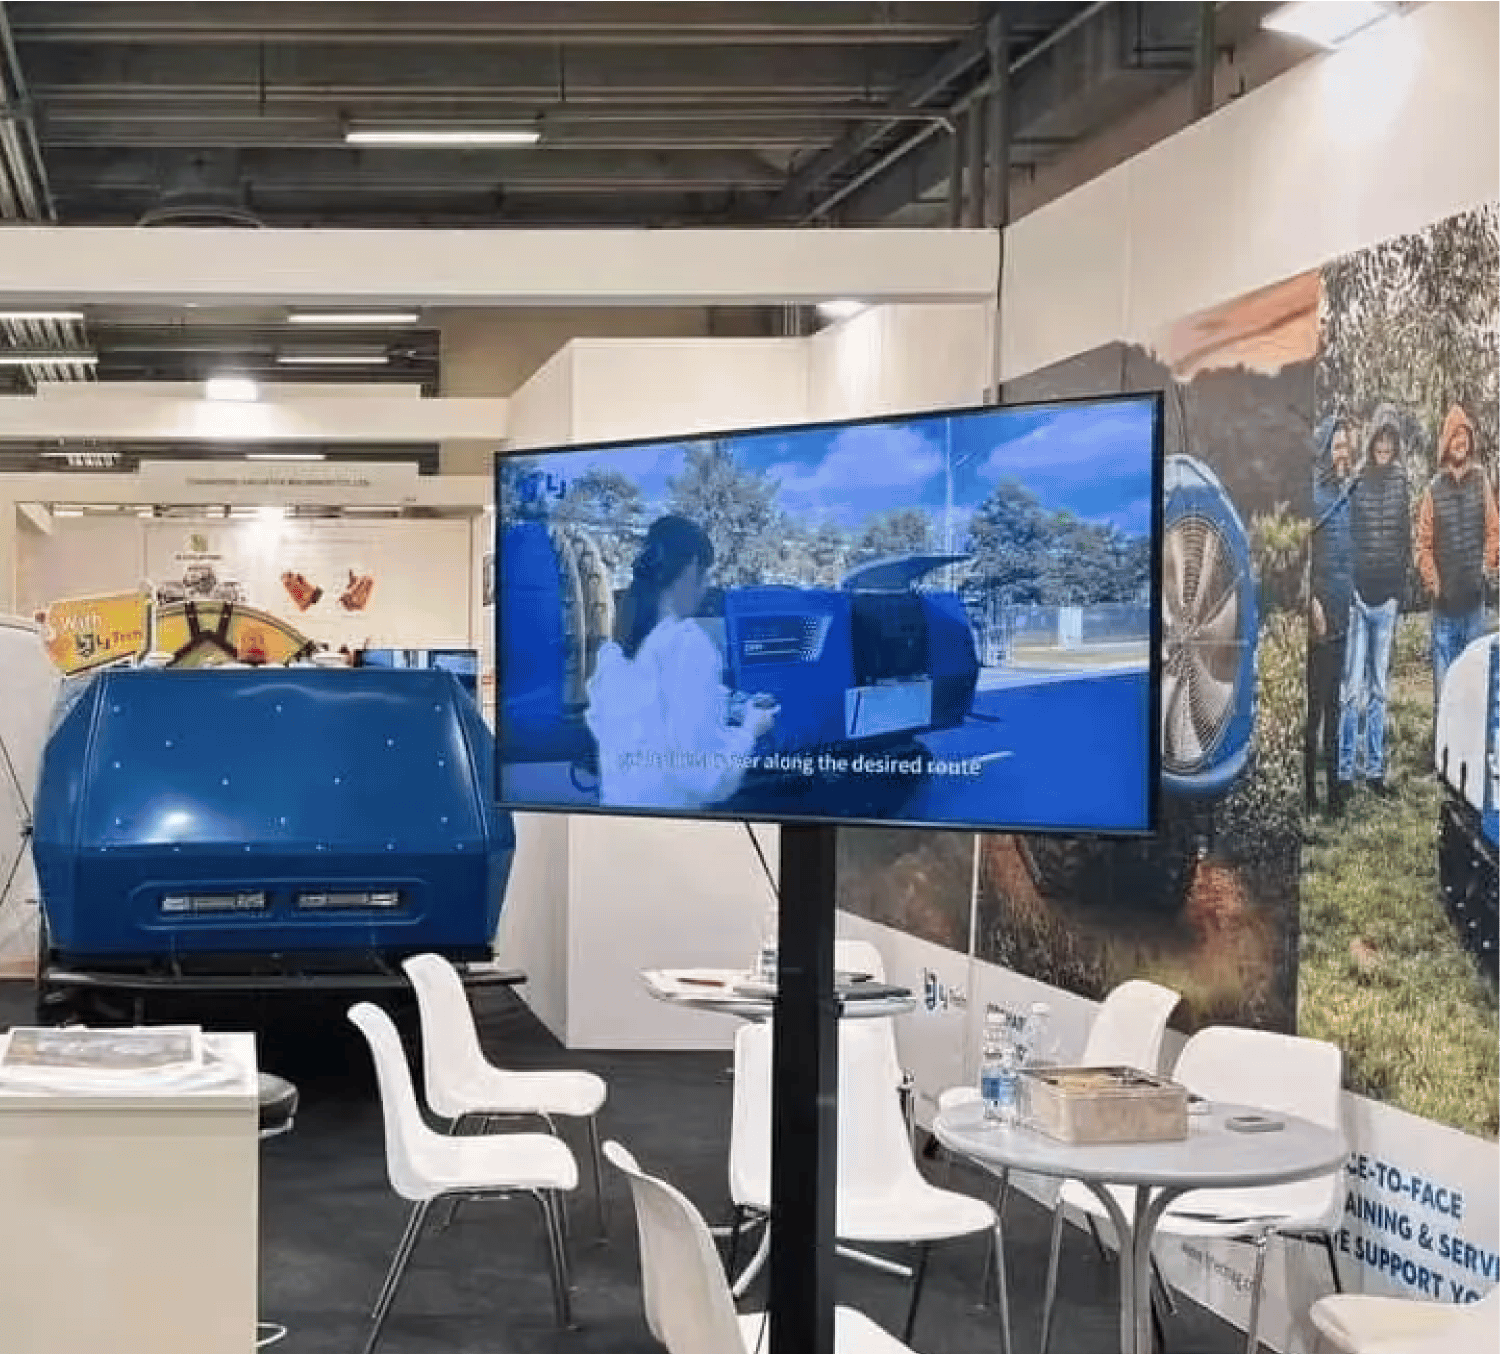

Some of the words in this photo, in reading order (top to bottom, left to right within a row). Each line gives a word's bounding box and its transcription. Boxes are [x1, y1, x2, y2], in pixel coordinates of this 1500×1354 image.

[763, 752, 814, 775] along
[818, 754, 848, 773] the
[852, 754, 922, 775] desired
[927, 760, 982, 776] route
[1418, 1222, 1433, 1251] &
[1355, 1236, 1443, 1301] SUPPORT
